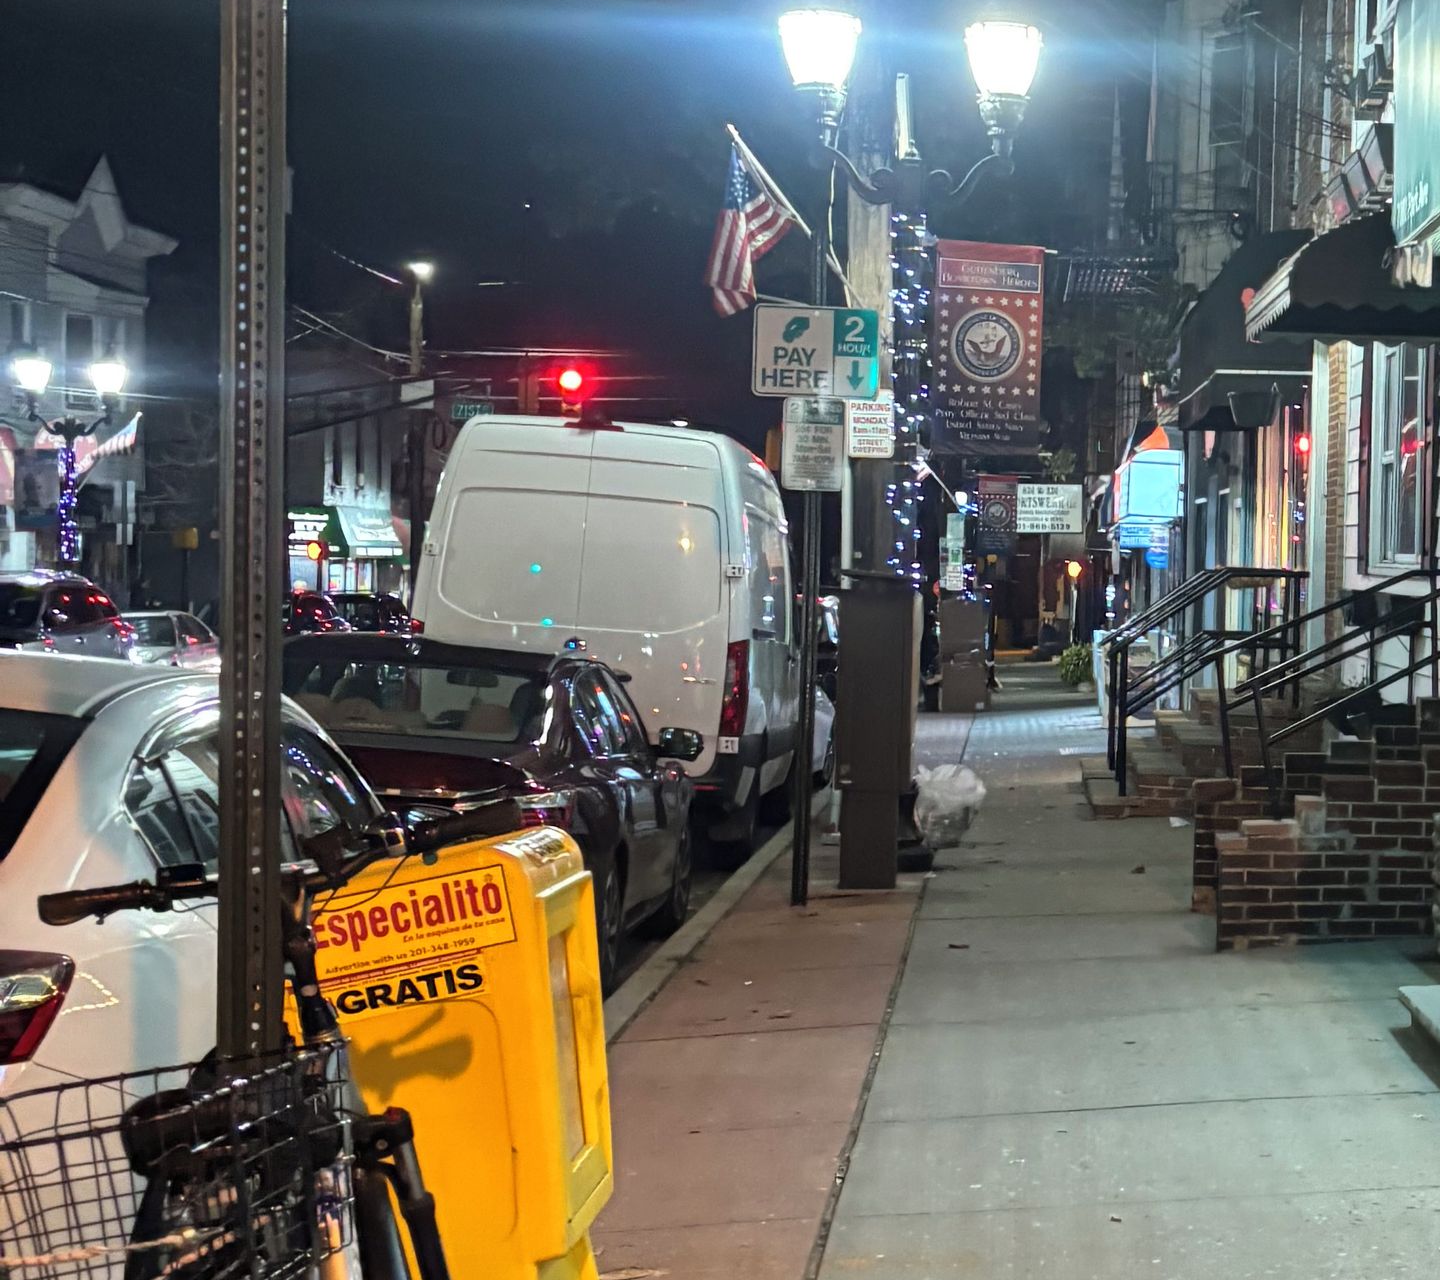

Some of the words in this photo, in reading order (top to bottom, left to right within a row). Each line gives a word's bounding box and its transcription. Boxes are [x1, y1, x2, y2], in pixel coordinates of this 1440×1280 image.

[845, 317, 865, 342] 2
[773, 346, 816, 366] PAY
[838, 343, 871, 356] HOUR
[761, 368, 828, 388] HERE
[851, 403, 890, 411] PARKING
[462, 921, 473, 931] de
[325, 958, 370, 975] Advertise
[372, 953, 394, 966] with
[396, 951, 408, 961] us
[336, 964, 483, 1014] GRATIS
